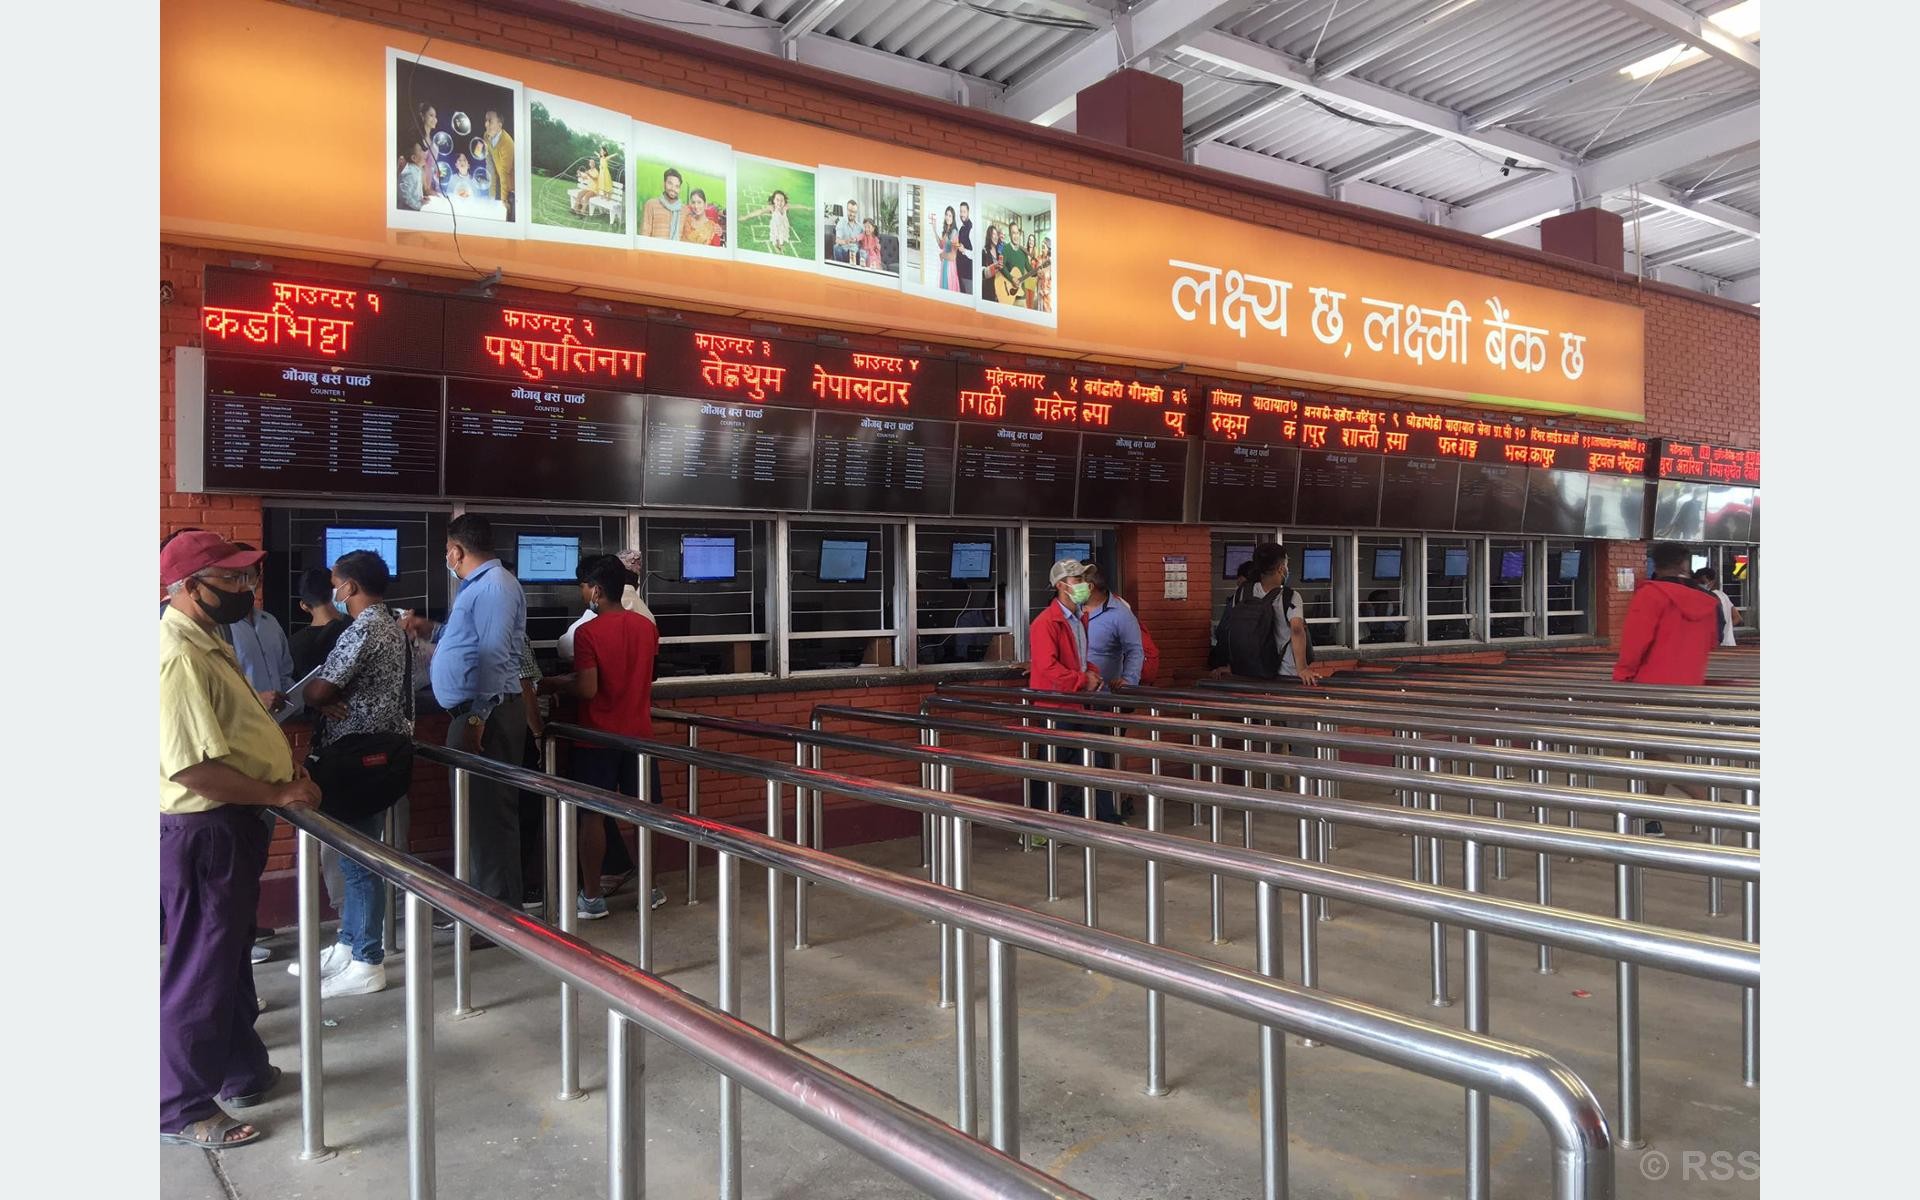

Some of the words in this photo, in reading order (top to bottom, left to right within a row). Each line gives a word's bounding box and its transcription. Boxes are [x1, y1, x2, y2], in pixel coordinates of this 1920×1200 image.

[272, 282, 356, 309] काउन्टर
[368, 294, 379, 313] १
[502, 309, 574, 334] काउन्टर
[583, 320, 594, 336] २
[1169, 259, 1292, 338] लक्ष्य
[1309, 287, 1352, 358] छ,
[1362, 298, 1472, 365] लक्ष्मी
[1484, 296, 1549, 373] बैंक
[1560, 331, 1586, 380] छ
[694, 332, 755, 354] काउन्टर
[852, 353, 904, 372] काउन्टर
[322, 373, 341, 385] बस
[346, 374, 372, 387] पार्क
[812, 364, 912, 406] नेपालटार
[310, 388, 340, 396] COUNTER
[534, 405, 560, 413] COUNTER
